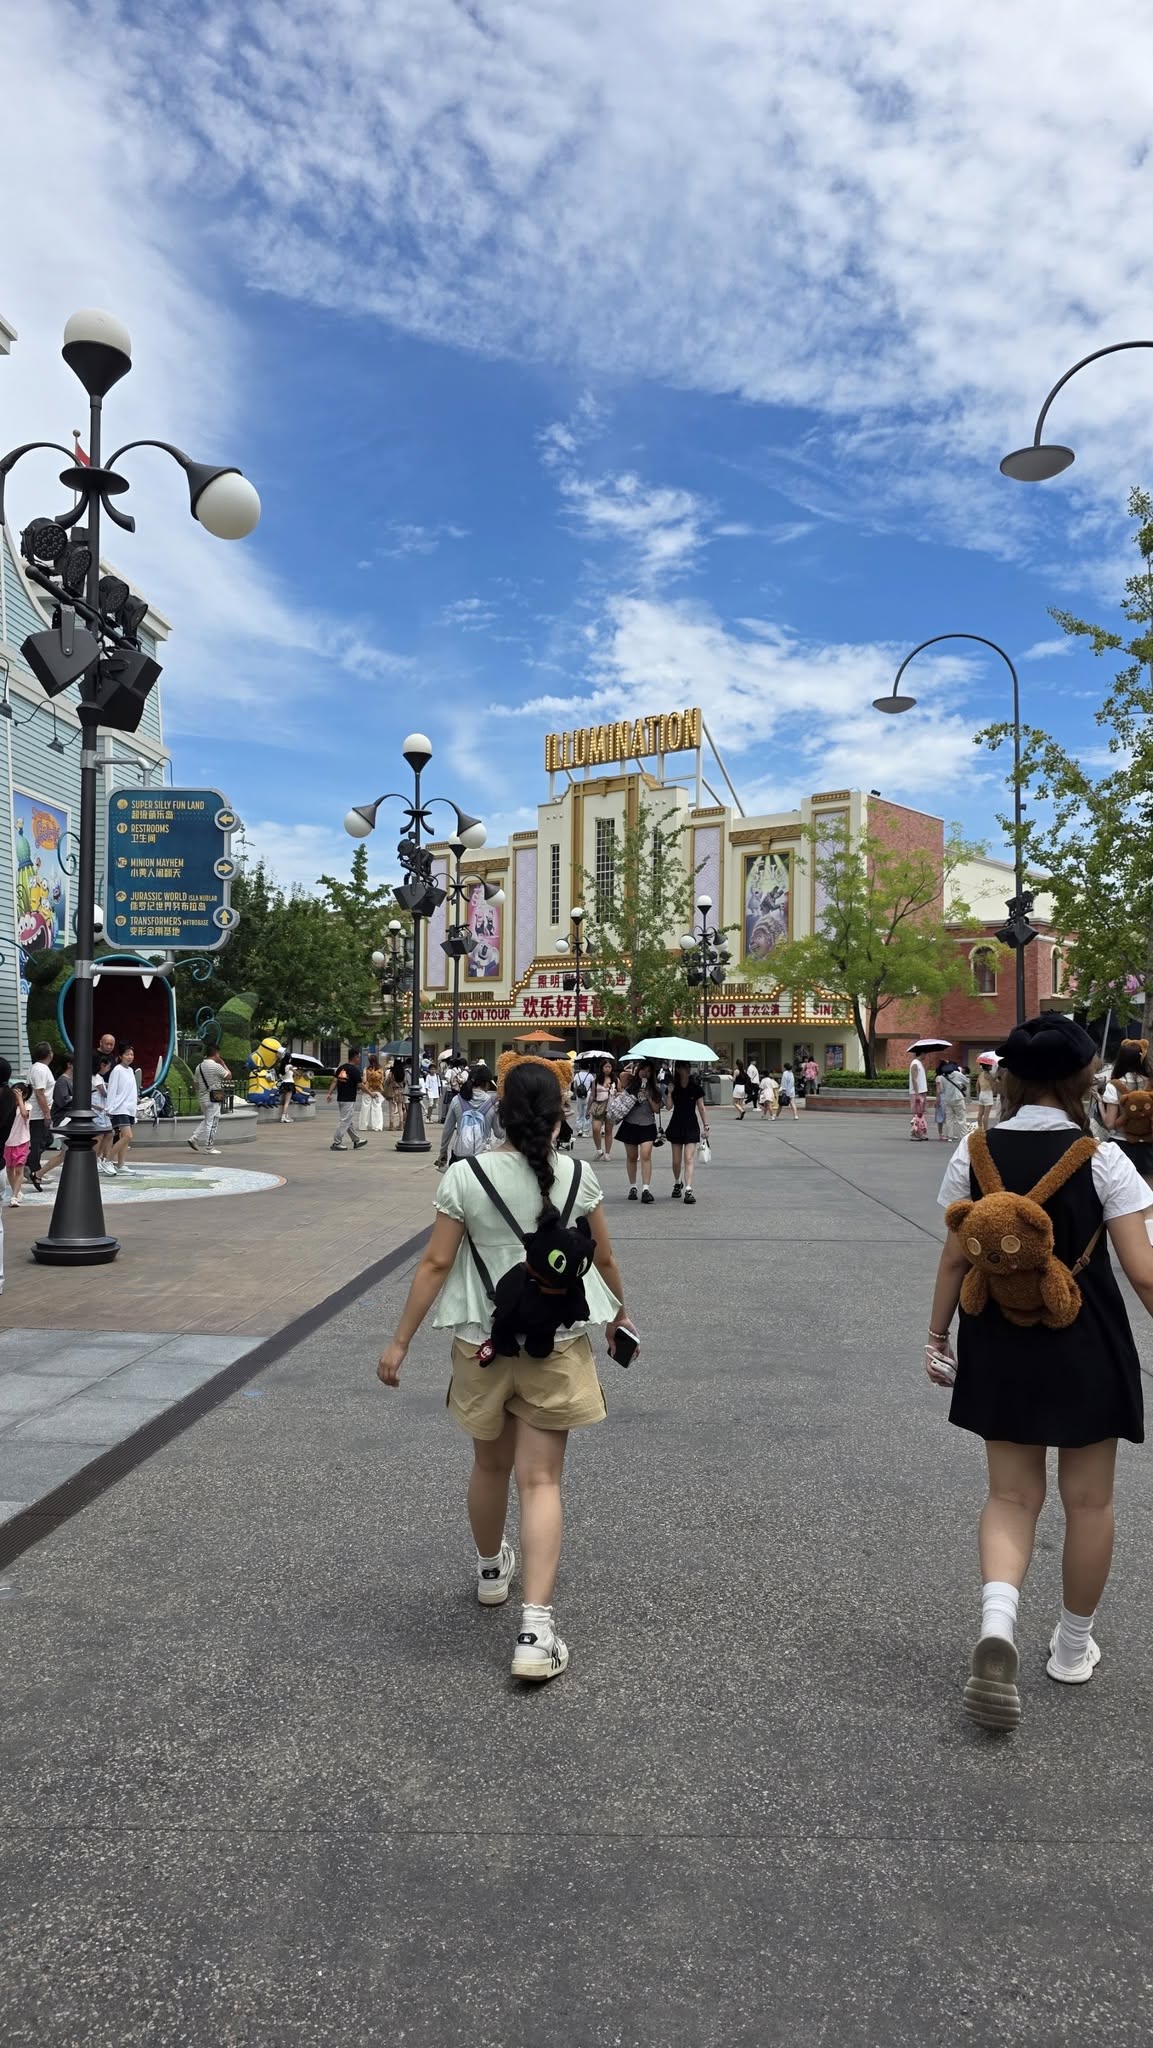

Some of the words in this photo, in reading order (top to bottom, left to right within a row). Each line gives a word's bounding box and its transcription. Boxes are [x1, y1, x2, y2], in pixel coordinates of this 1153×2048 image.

[545, 708, 701, 772] ILLUMINATION
[131, 800, 154, 810] SUPER
[154, 800, 172, 810] SILLY
[173, 800, 186, 810] FUN
[187, 800, 205, 810] LAND
[131, 824, 170, 833] RESTROOMS
[131, 833, 156, 843] 卫生间
[130, 858, 155, 867] MINION
[156, 858, 184, 867] MAYHEM
[130, 892, 163, 901] JURASSIC
[163, 892, 188, 901] WORLD
[130, 917, 182, 926] TRANSFORMERS
[130, 926, 180, 936] 变形金刚基地
[470, 1009, 484, 1021] ON
[486, 1008, 511, 1020] TOUR
[705, 1004, 737, 1018] TOUR
[742, 1004, 781, 1017] 首次公演
[812, 1004, 838, 1017] SIN
